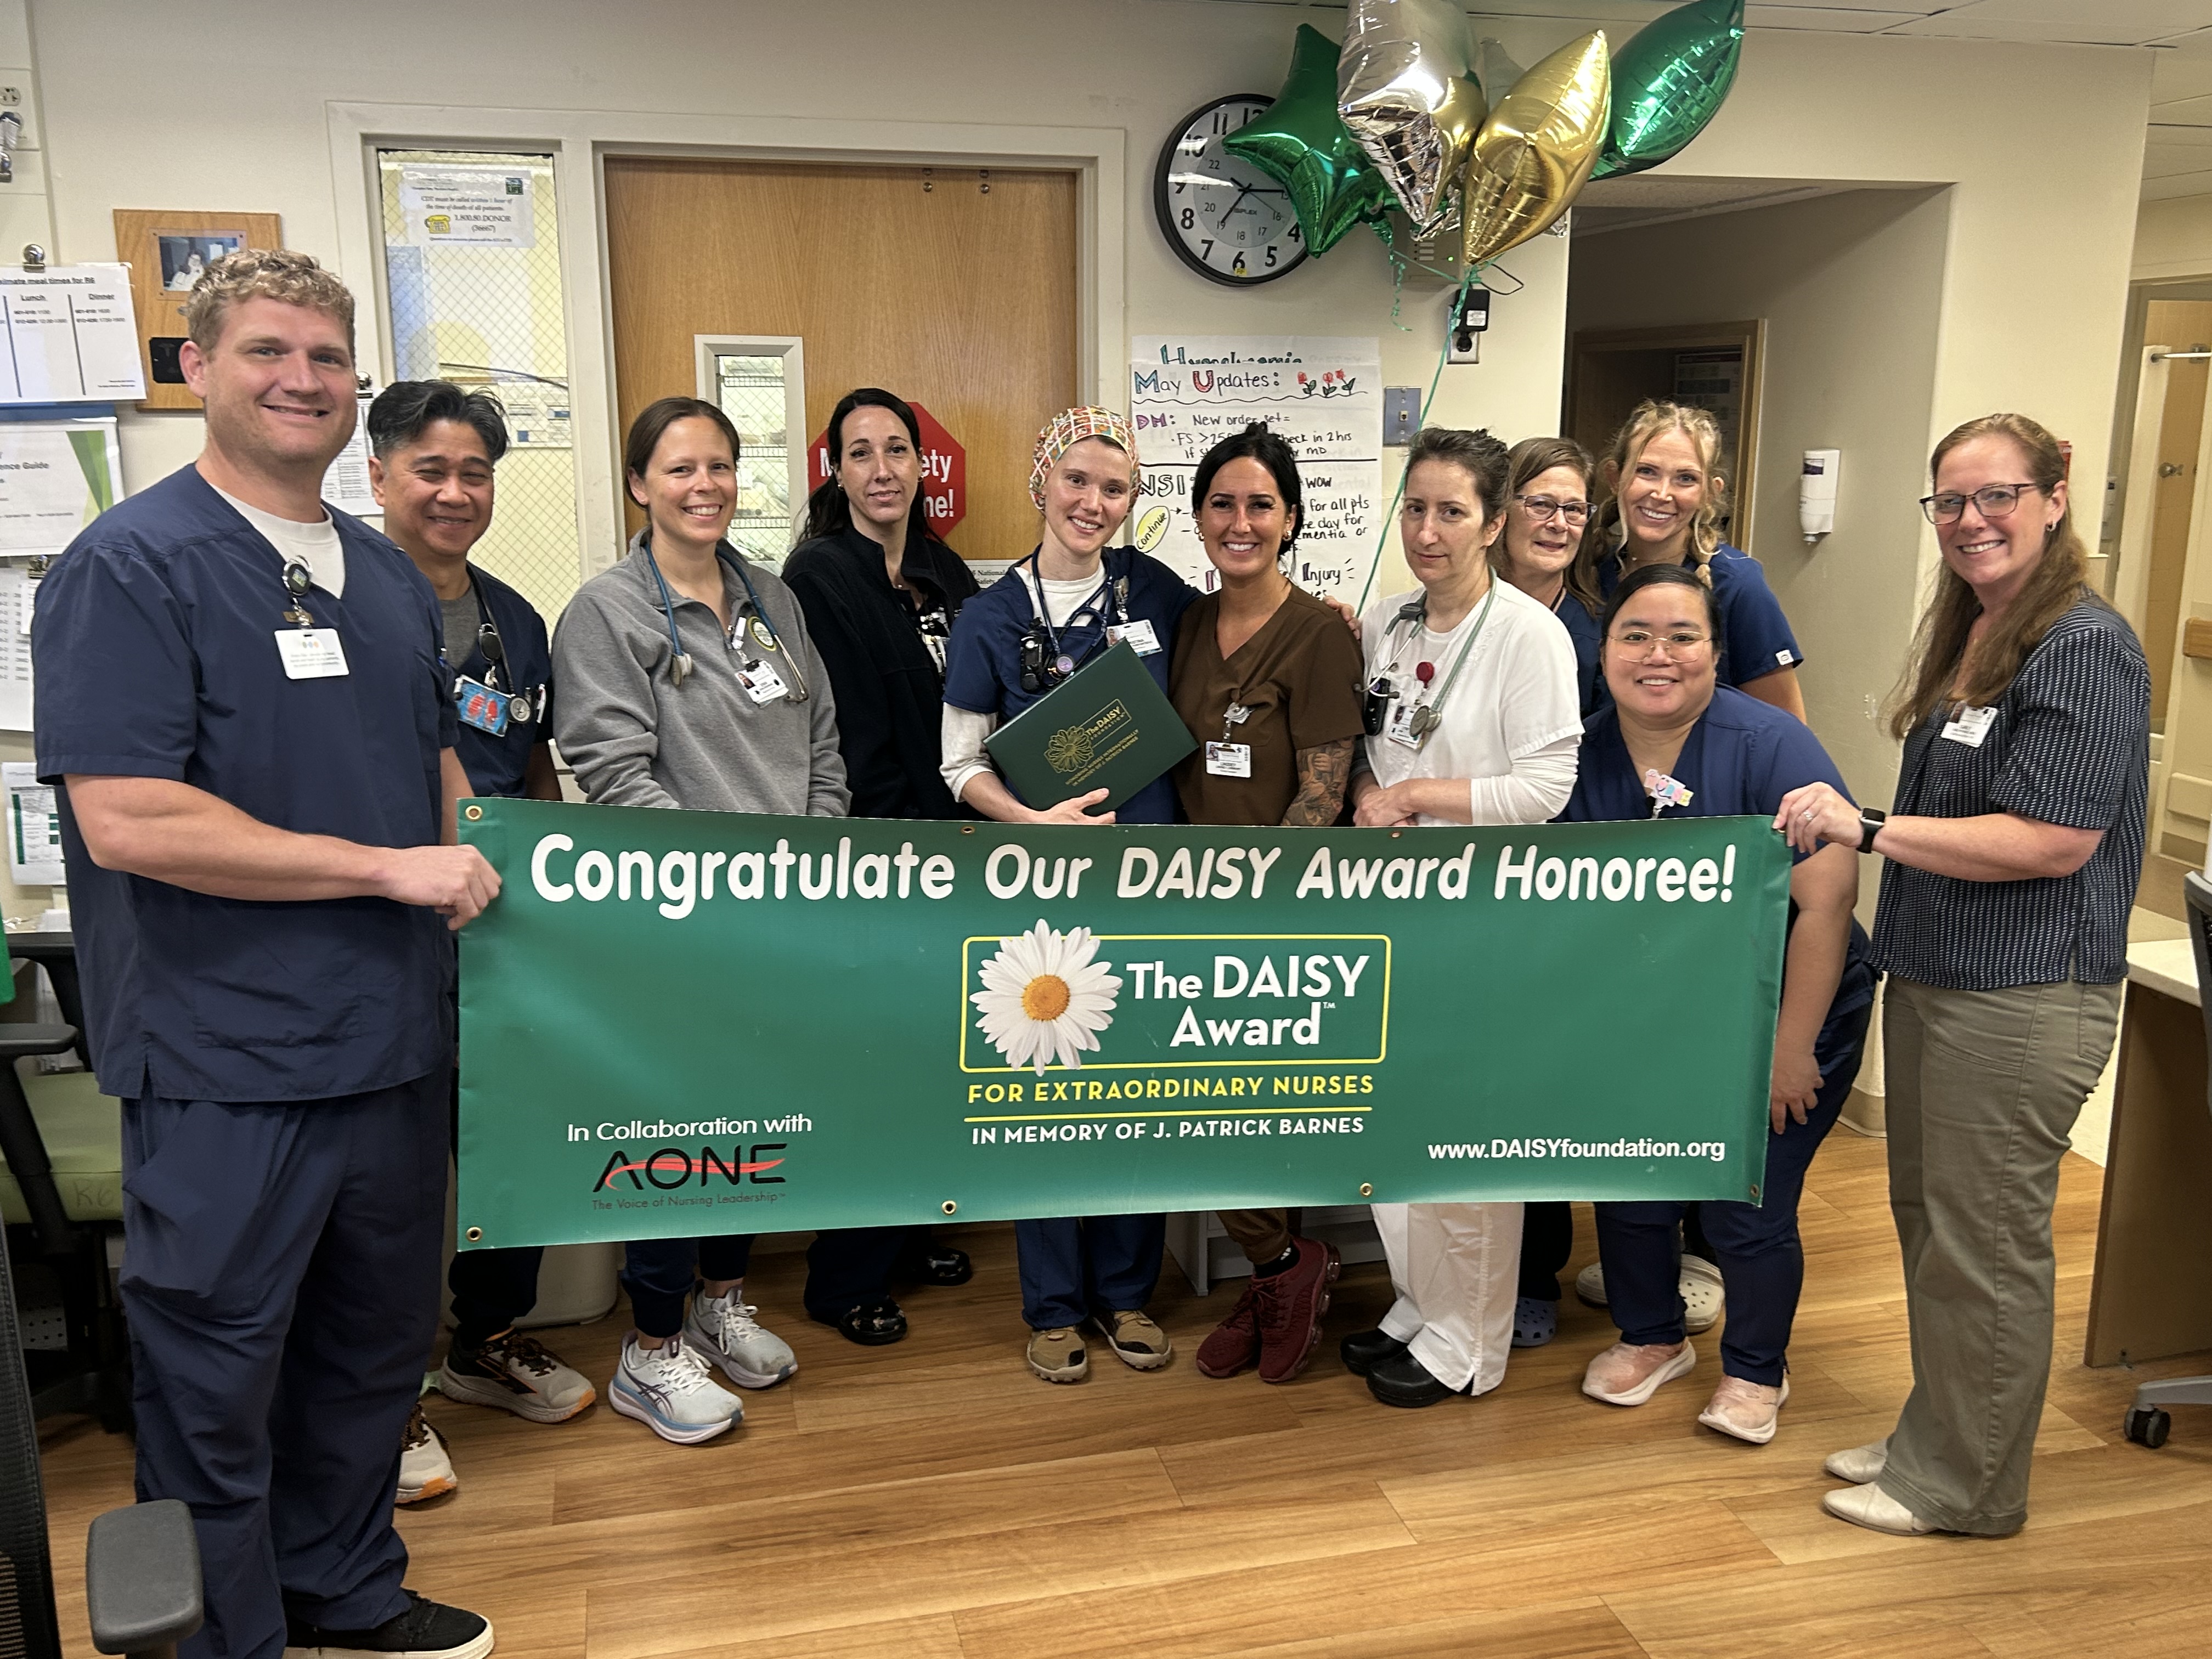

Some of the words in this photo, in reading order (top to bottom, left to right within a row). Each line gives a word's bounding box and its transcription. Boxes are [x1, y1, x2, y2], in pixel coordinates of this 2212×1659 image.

[1212, 112, 1228, 136] 11
[1209, 160, 1220, 170] 22
[1204, 202, 1216, 212] 20
[1181, 208, 1194, 230] 8
[1237, 230, 1245, 240] 18
[1257, 227, 1268, 236] 17
[1288, 222, 1300, 243] 4
[1201, 239, 1214, 261] 7
[1265, 246, 1278, 267] 5
[1232, 251, 1245, 271] 6
[1134, 369, 1181, 395] May
[1193, 369, 1279, 397] Updates:
[1136, 413, 1176, 431] DM:
[1193, 414, 1222, 426] New
[1176, 432, 1194, 446] FS
[1313, 431, 1323, 443] in
[22, 461, 50, 470] Guide
[1310, 498, 1327, 512] for
[1330, 497, 1347, 510] all
[1350, 494, 1370, 515] pts
[1317, 517, 1340, 529] day
[1344, 512, 1364, 525] for
[1302, 562, 1341, 586] Injury
[1096, 706, 1122, 729] DAISY
[531, 833, 955, 920] Congratulate
[985, 844, 1092, 899] Our
[1117, 847, 1281, 899] DAISY
[1296, 843, 1475, 900] Award
[1494, 844, 1736, 902] Honoree!
[1126, 961, 1203, 999] The
[1213, 955, 1370, 998] DAISY
[968, 1084, 1024, 1103] FOR
[1035, 1077, 1263, 1101] EXTRAORDINARY
[1273, 1075, 1373, 1095] NURSES
[568, 1124, 589, 1142] In
[596, 1116, 757, 1140] Collaboration
[763, 1113, 812, 1133] with
[972, 1127, 996, 1144] IN
[1005, 1124, 1108, 1143] MEMORY
[1115, 1122, 1146, 1139] OF
[1153, 1122, 1172, 1138] J.
[1179, 1119, 1272, 1137] PATRICK
[1279, 1117, 1364, 1135] BARNES
[1427, 1138, 1726, 1161] www.DAISYfoundation.org
[592, 1143, 788, 1193] AONE
[592, 1199, 613, 1210] The
[617, 1198, 648, 1209] Voice
[652, 1195, 665, 1207] of
[668, 1195, 714, 1207] Nursing
